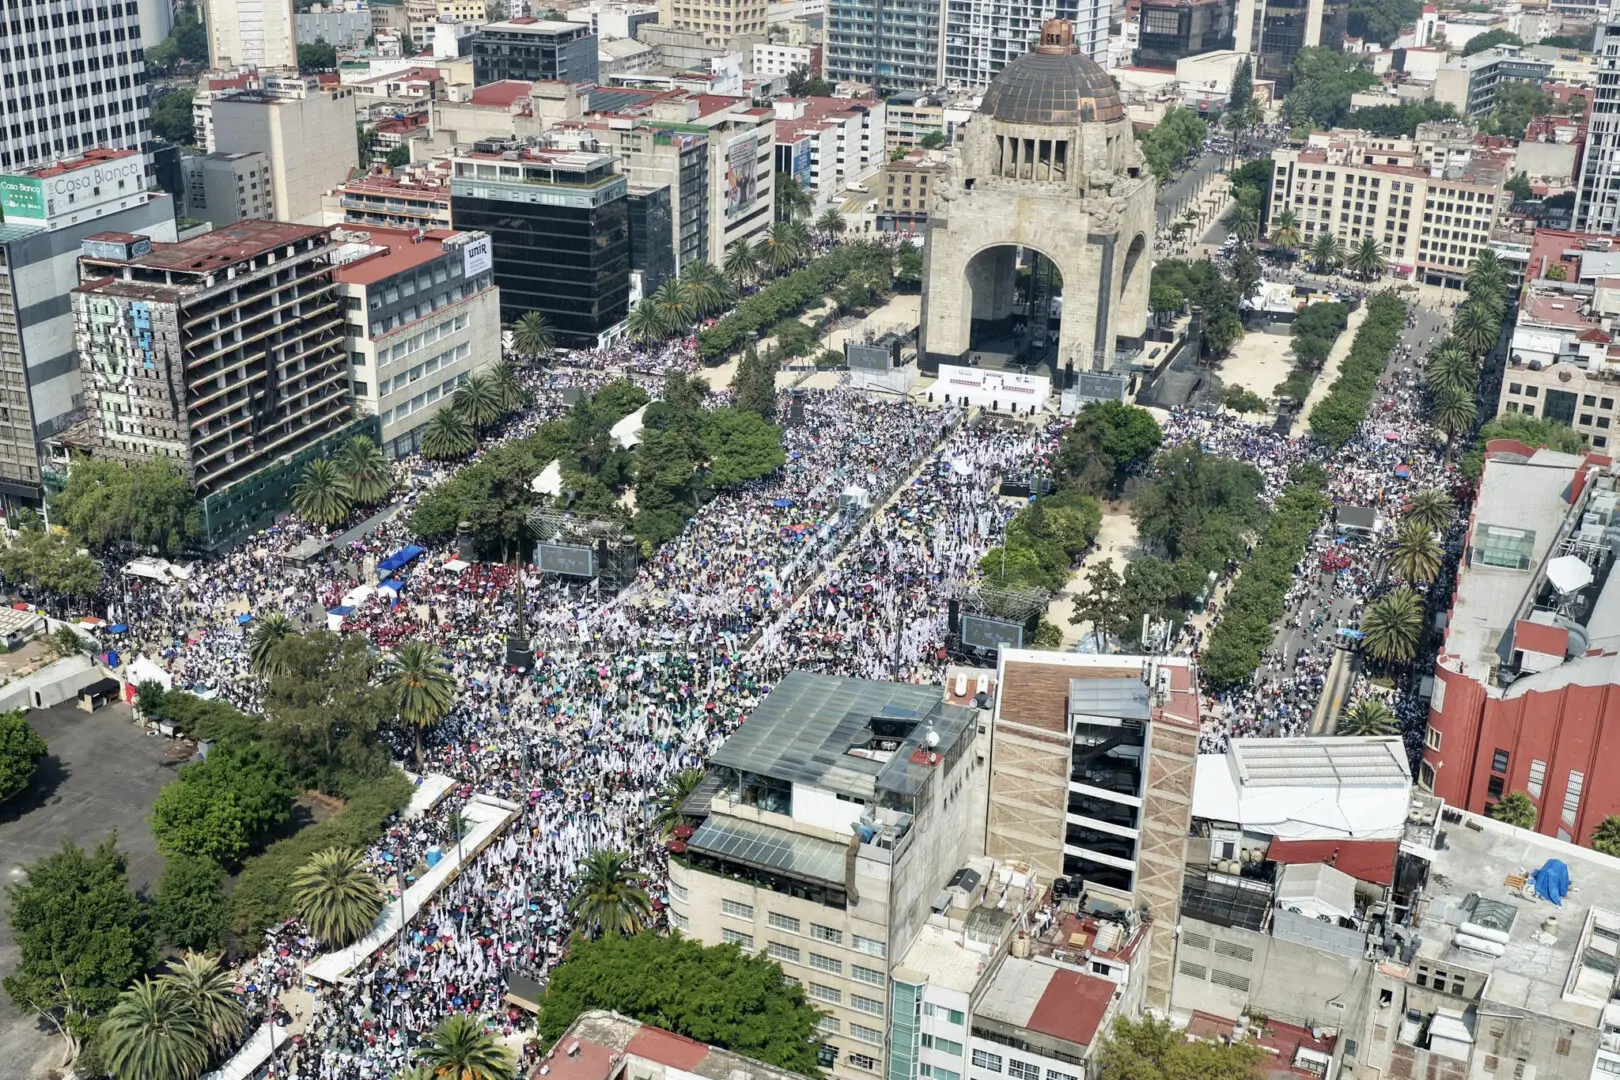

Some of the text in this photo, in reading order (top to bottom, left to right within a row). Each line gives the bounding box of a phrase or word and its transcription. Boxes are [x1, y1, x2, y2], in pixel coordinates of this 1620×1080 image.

[267, 82, 283, 90] HOTEL
[55, 176, 91, 195] Casa
[94, 163, 138, 184] Blanca
[1, 181, 18, 190] Casa
[19, 183, 40, 193] Blanca
